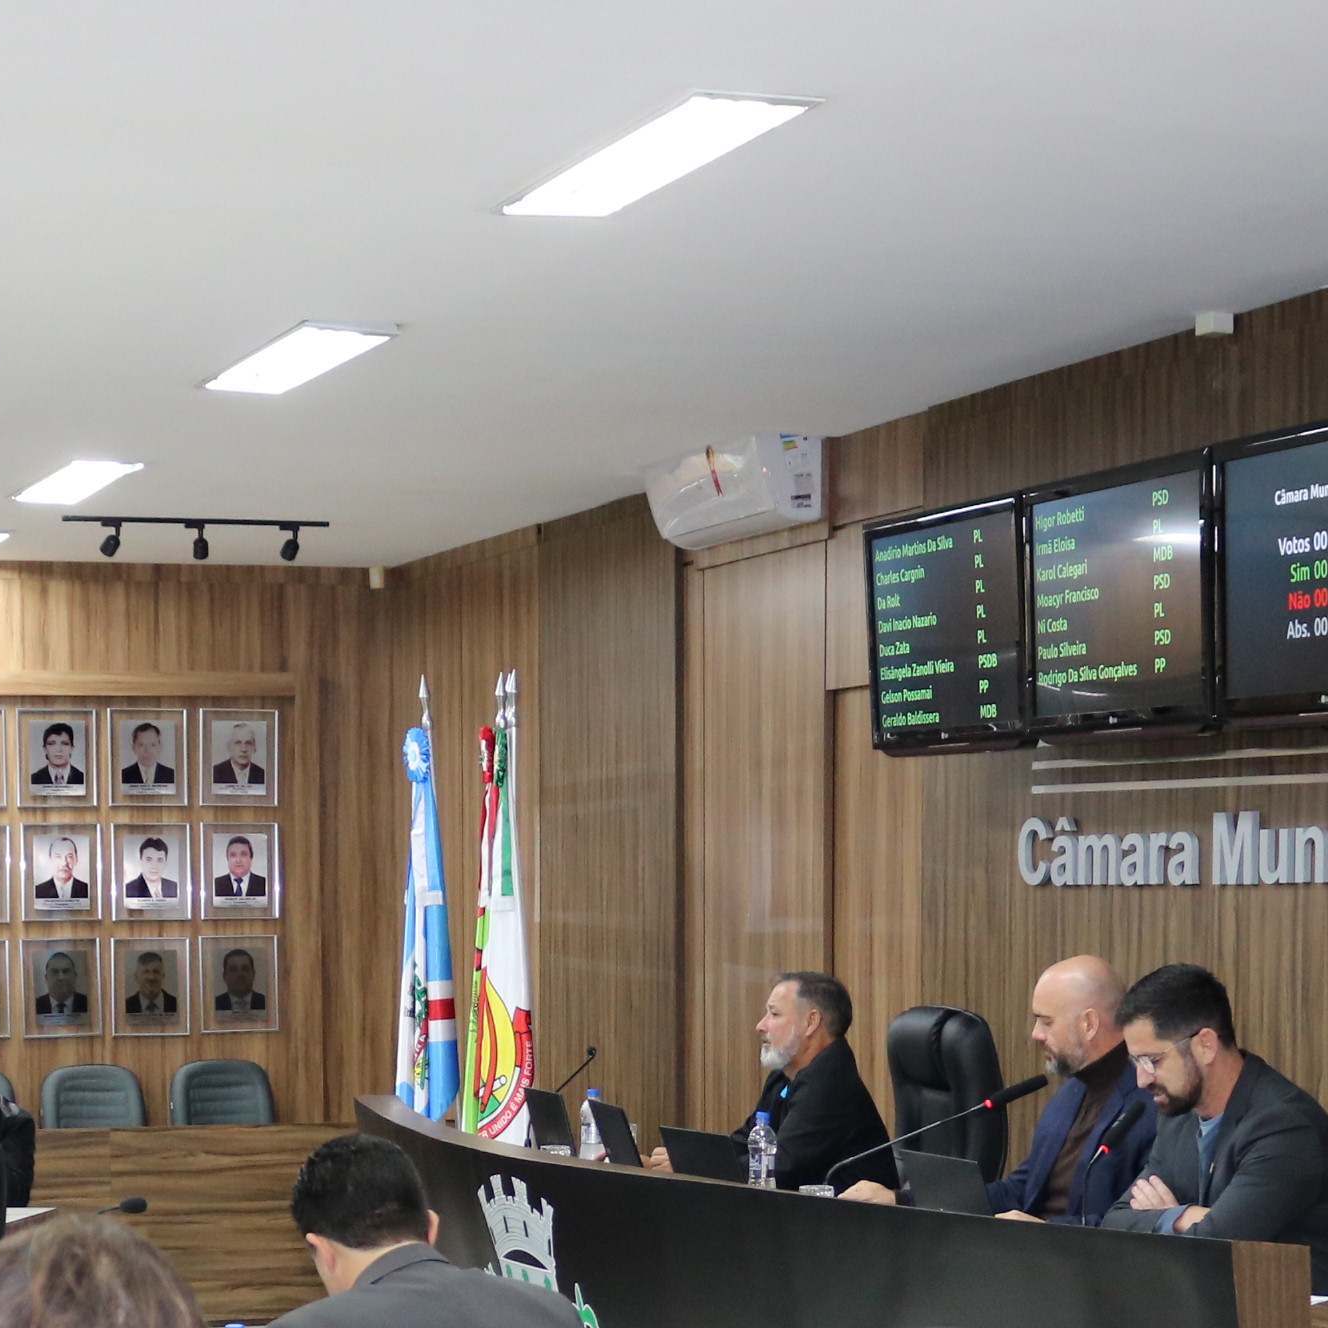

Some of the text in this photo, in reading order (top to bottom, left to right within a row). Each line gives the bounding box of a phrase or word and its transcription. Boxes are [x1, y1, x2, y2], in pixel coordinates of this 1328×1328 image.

[1035, 489, 1169, 531] Higor Robetti PSD
[1274, 488, 1308, 505] Câmara
[1152, 519, 1163, 534] PL
[902, 541, 926, 557] Martins
[927, 539, 936, 552] Da
[937, 535, 953, 551] Silva
[973, 529, 983, 543] PL
[1278, 537, 1310, 556] Votos
[1313, 530, 1328, 550] 00
[876, 554, 984, 586] Charles Cargnin PL
[1036, 545, 1173, 582] Karol Calegari MDB
[1290, 563, 1310, 583] Sim
[1314, 559, 1328, 580] 00
[877, 579, 985, 610] Da Rolt PL
[1037, 573, 1170, 608] Moacyr Francisco PSD
[1288, 588, 1328, 610] Não 00
[878, 619, 892, 633] Davi
[976, 604, 986, 618] PL
[1037, 602, 1165, 634] Ni Costa PL
[1287, 616, 1328, 639] Abs. 00
[879, 644, 894, 657] Duca
[977, 630, 987, 644] PL
[1038, 629, 1171, 660] Paulo Silveira PSD
[934, 659, 955, 674] Vieira
[978, 653, 998, 669] PSDB
[1038, 658, 1166, 687] Rodrigo Da Silva Gonçalves PP
[881, 679, 989, 704] Gelson Possamai PP
[882, 704, 997, 728] Geraldo Baldissera MDB
[1017, 816, 1199, 886] Câmara
[488, 1110, 512, 1135] UNIDO
[510, 1101, 518, 1111] É
[524, 1041, 533, 1076] FORTE
